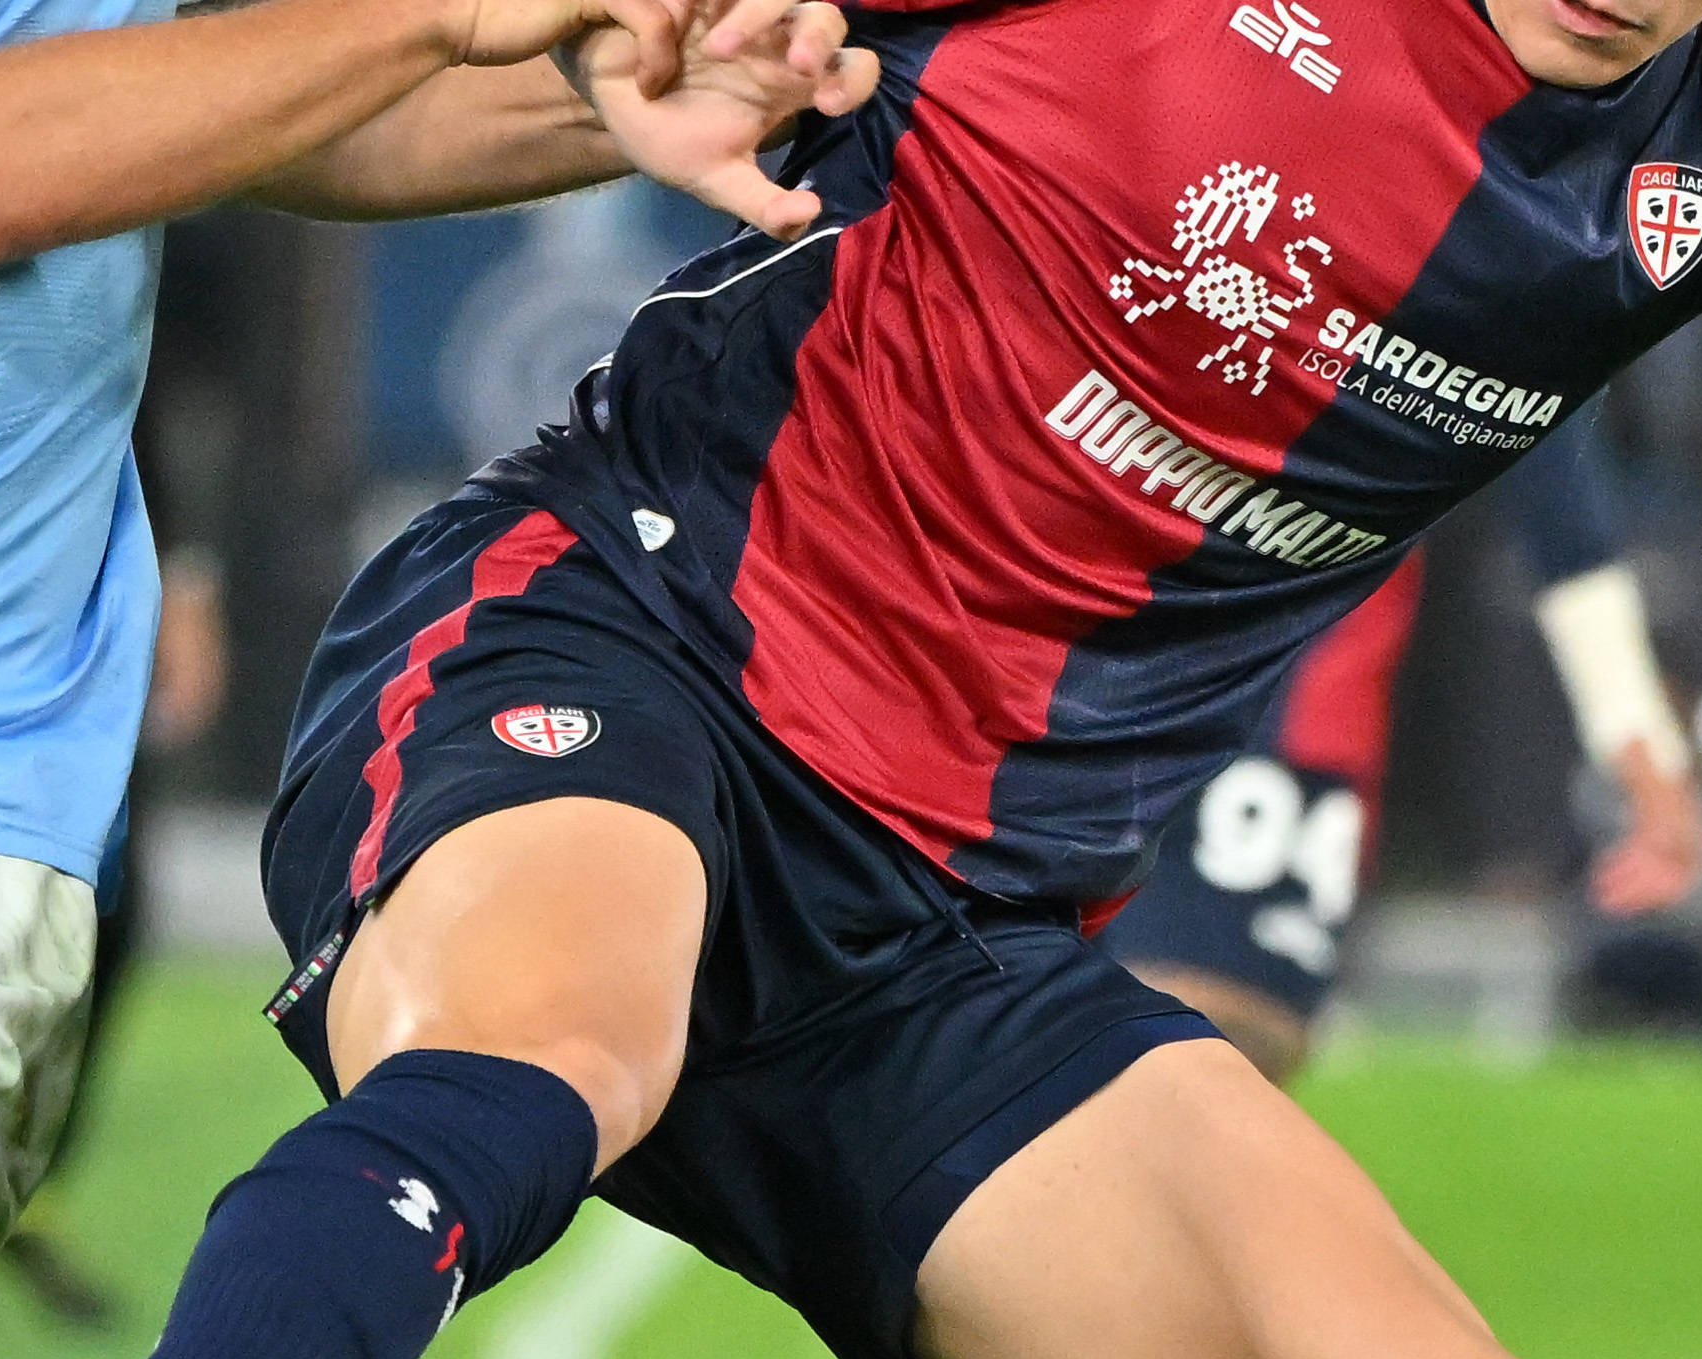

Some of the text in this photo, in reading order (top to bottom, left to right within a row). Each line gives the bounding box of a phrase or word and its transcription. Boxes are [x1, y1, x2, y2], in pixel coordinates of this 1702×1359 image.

[1297, 347, 1536, 450] ISOLA dell'Artigianato
[1316, 307, 1563, 428] SARDEGNA
[1044, 368, 1257, 524] DOPPIO
